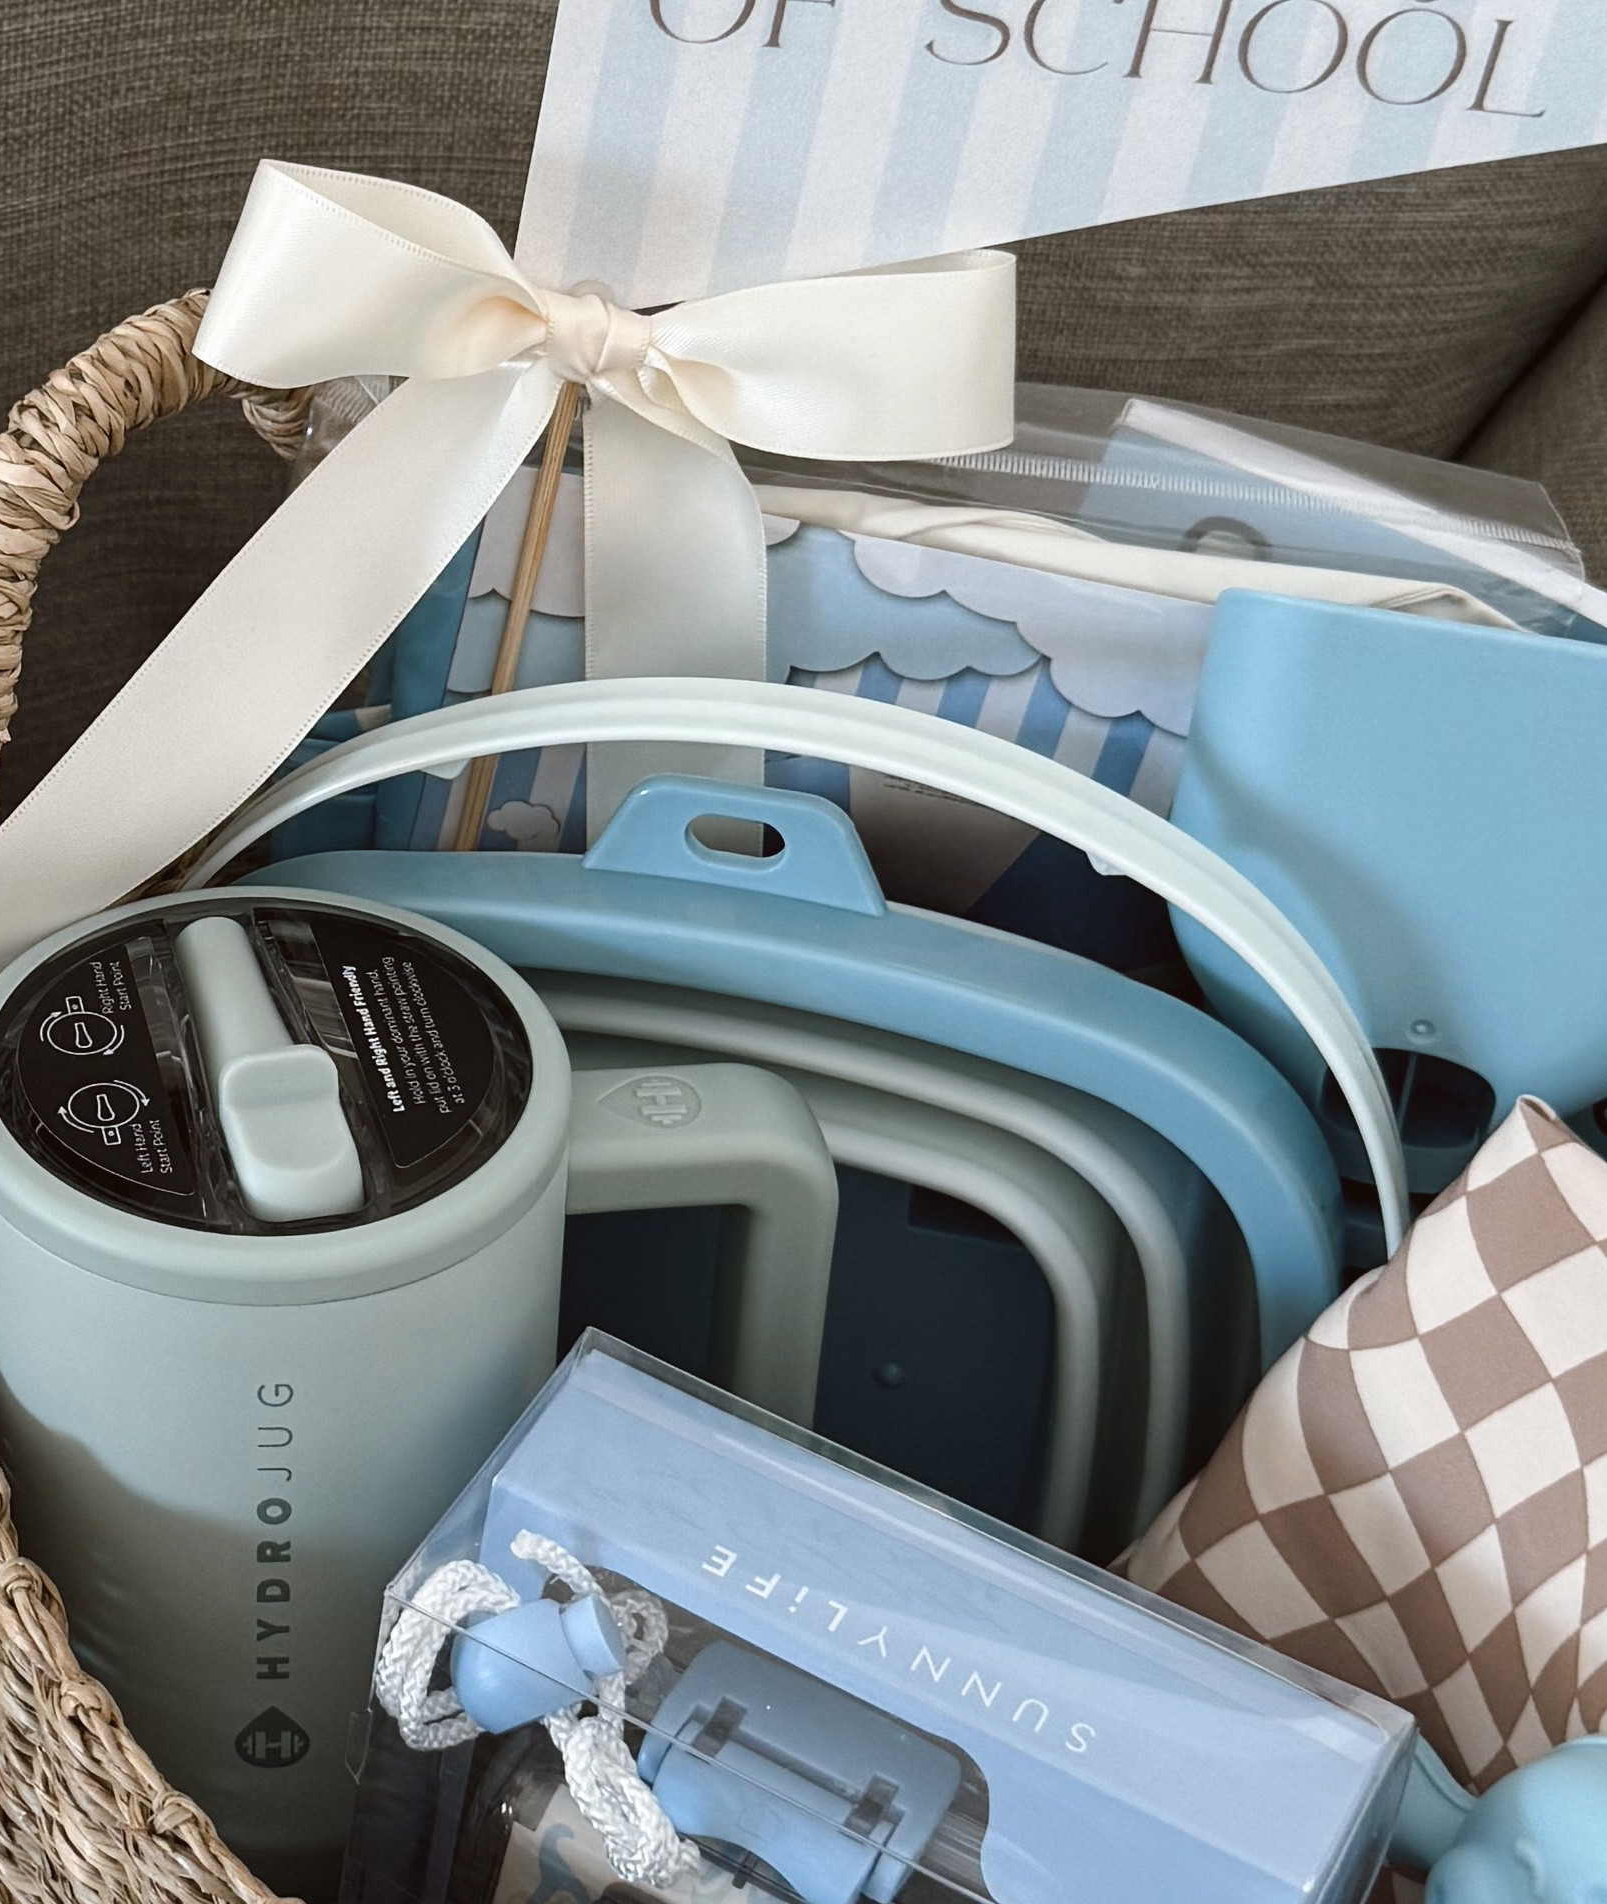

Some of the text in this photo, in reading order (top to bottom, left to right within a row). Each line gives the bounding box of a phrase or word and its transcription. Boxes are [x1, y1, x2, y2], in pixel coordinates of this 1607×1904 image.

[90, 962, 115, 1015] Right Hand
[109, 961, 132, 1011] Start Point
[382, 956, 407, 996] pointing
[377, 997, 403, 1044] dominant
[398, 997, 415, 1024] straw
[420, 1008, 435, 1028] turn
[342, 966, 405, 1112] Left and Right Hand Friendly
[408, 1026, 422, 1041] the
[426, 1030, 443, 1048] and
[396, 1046, 416, 1068] your
[414, 1044, 430, 1064] with
[424, 1067, 436, 1080] on
[408, 1080, 426, 1105] Hold
[434, 1096, 452, 1113] put
[130, 1123, 154, 1174] Left Hand
[149, 1120, 173, 1174] Start Point
[257, 1381, 293, 1681] HYDROJUG
